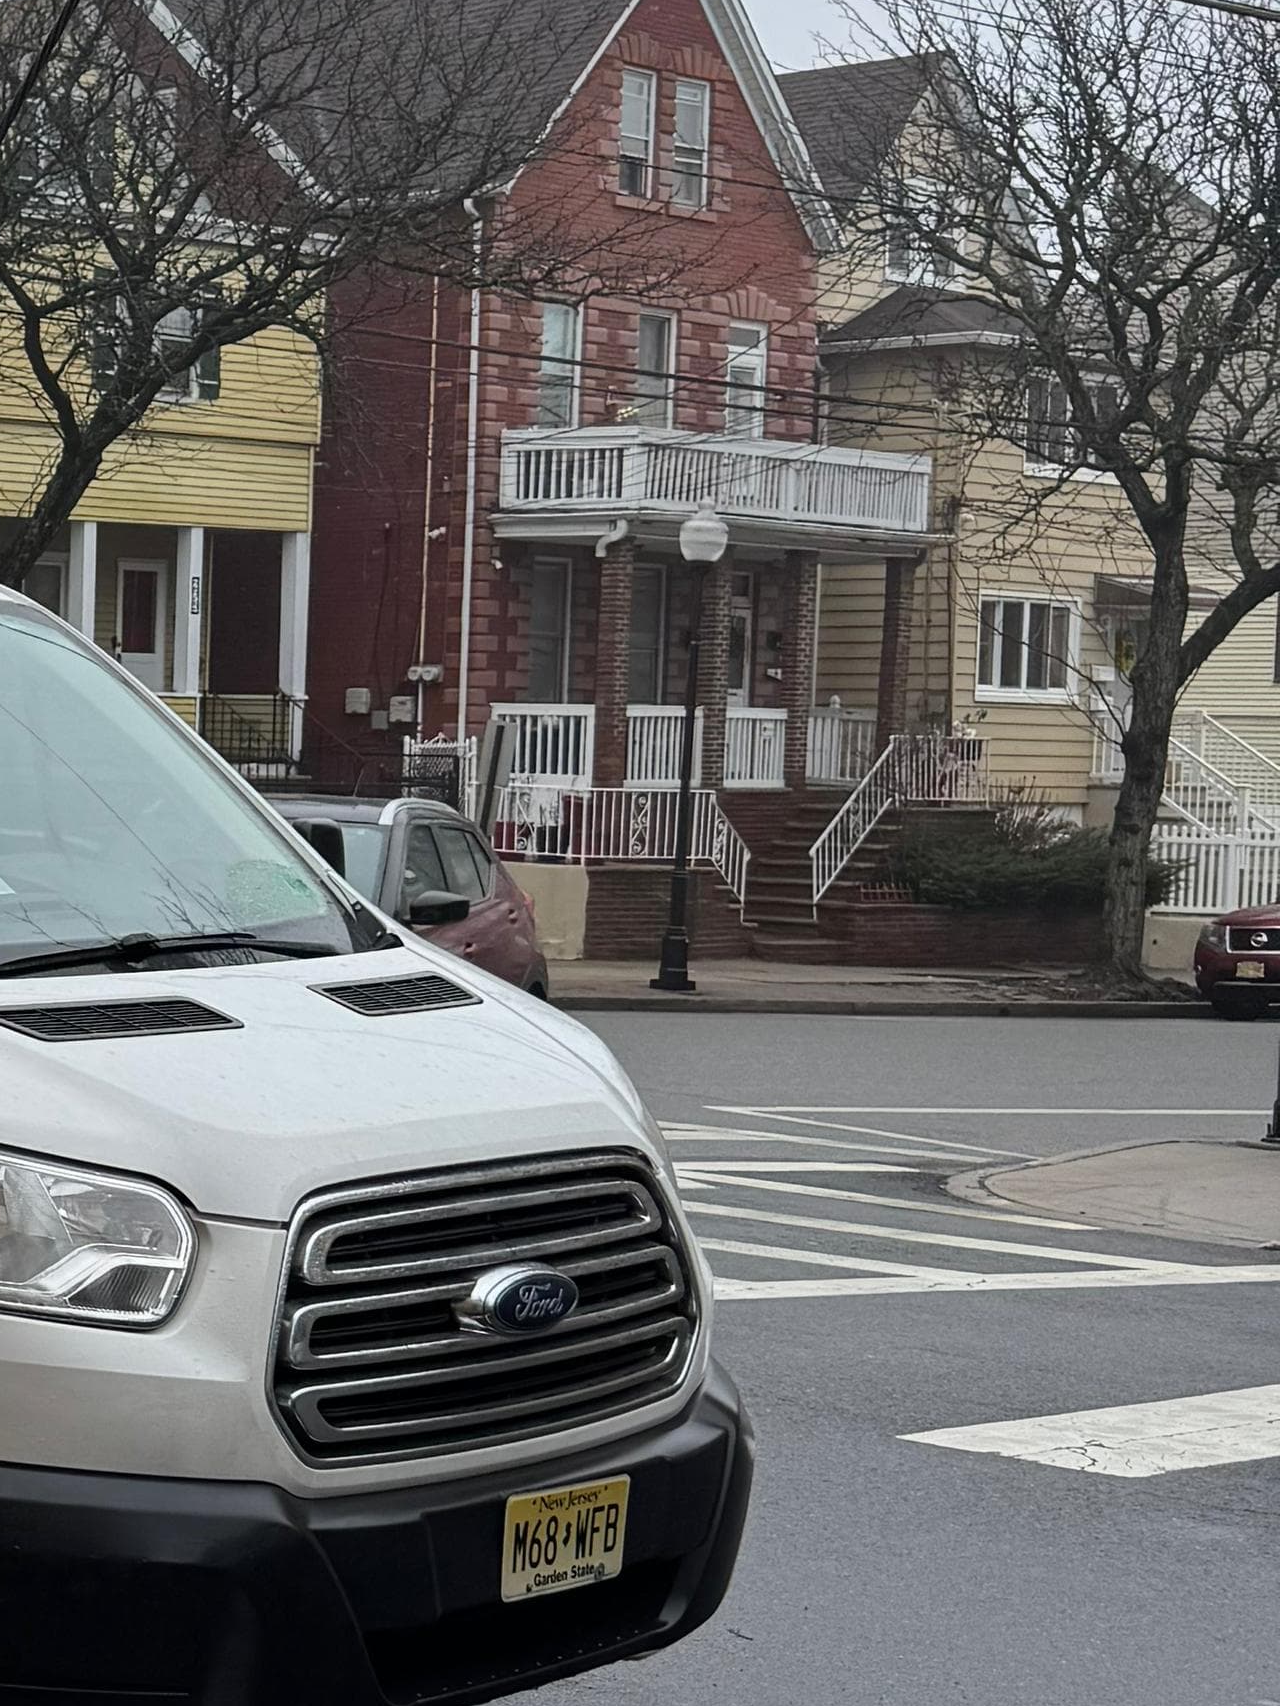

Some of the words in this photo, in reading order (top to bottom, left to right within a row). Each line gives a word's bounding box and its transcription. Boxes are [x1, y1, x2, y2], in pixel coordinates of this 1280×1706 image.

[515, 1283, 564, 1321] Ford
[538, 1495, 563, 1513] New
[565, 1491, 601, 1511] Jersey
[512, 1515, 559, 1574] M68
[575, 1503, 619, 1560] WFB
[533, 1570, 568, 1587] Garden
[570, 1563, 595, 1579] State
